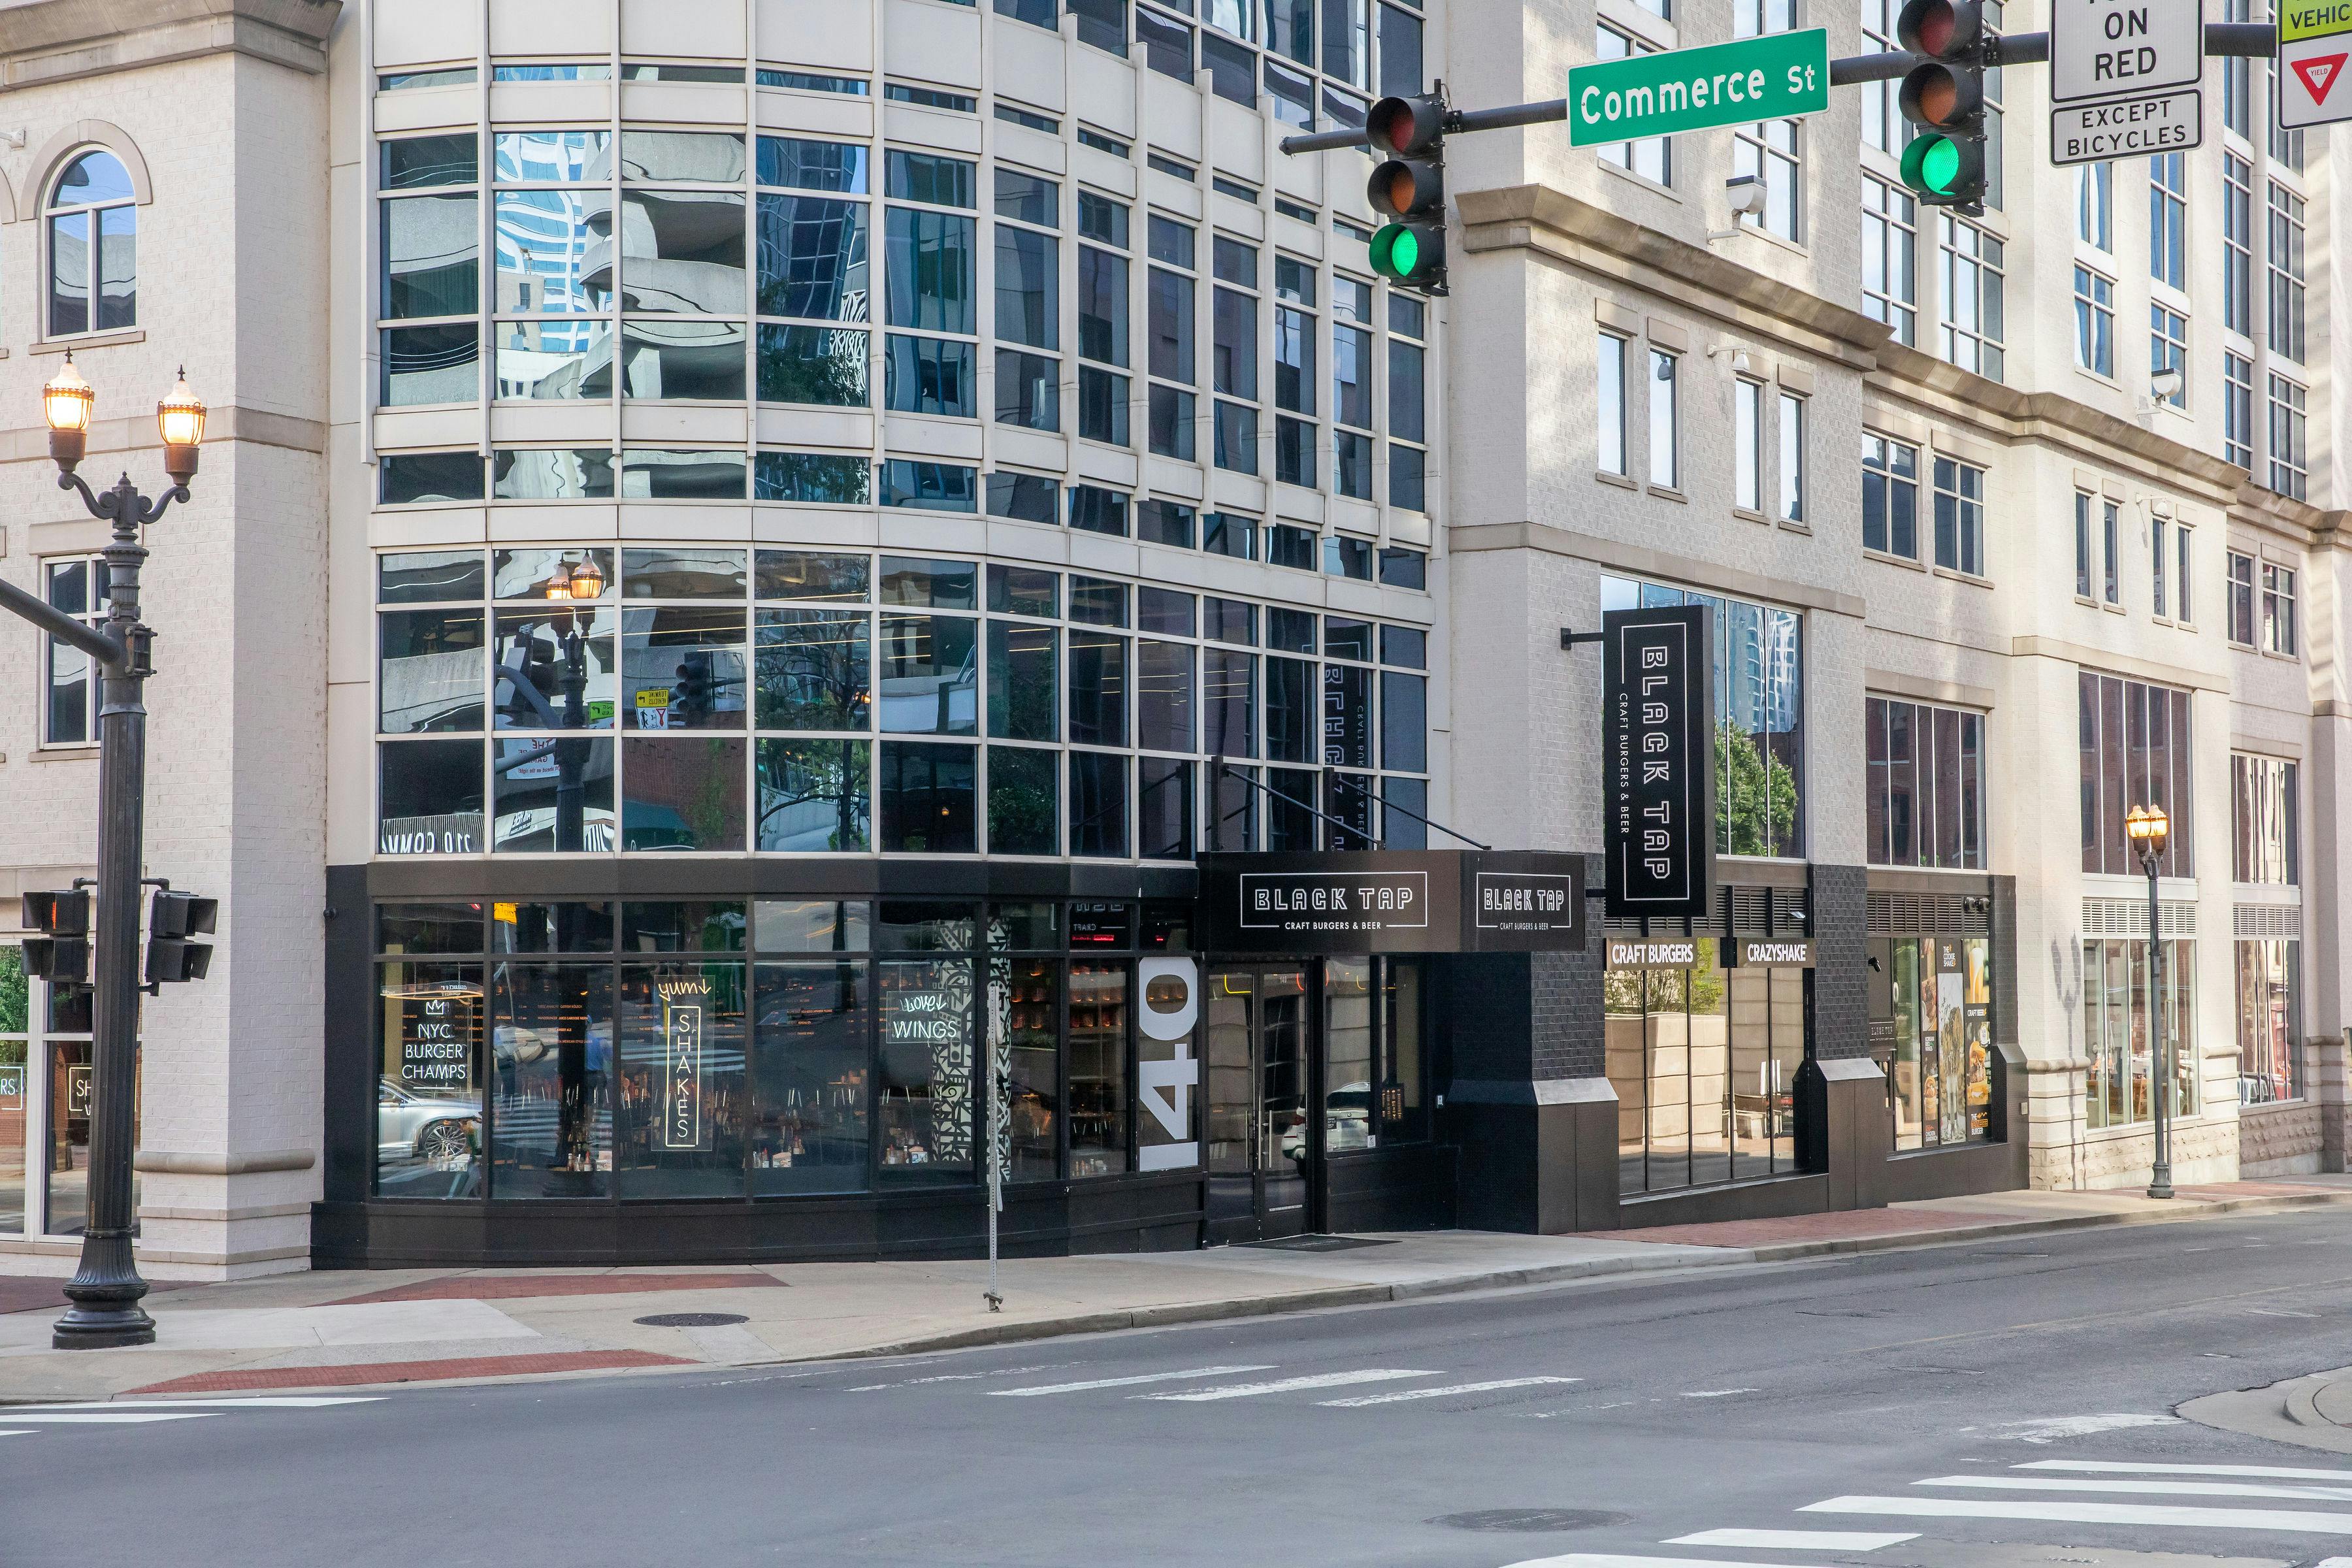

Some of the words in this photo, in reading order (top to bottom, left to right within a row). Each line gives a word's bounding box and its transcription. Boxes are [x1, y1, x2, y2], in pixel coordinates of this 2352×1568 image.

[2104, 8, 2148, 40] ON
[2095, 46, 2157, 81] RED
[2310, 67, 2328, 76] YIELD
[1581, 69, 1765, 124] Commerce
[1788, 64, 1815, 94] St
[2082, 100, 2171, 129] EXCEPT
[2067, 124, 2186, 157] BICYCLES
[1619, 693, 1629, 730] CRAFT
[1642, 645, 1670, 785] BLACK
[1620, 734, 1629, 788] BURGERS
[1620, 792, 1629, 801] &
[1620, 806, 1629, 834] BEER
[1644, 800, 1671, 879] TAP
[1254, 887, 1347, 911] BLACK
[1359, 887, 1413, 910] TAP
[1484, 888, 1533, 911] BLACK
[1537, 889, 1564, 911] TAP
[1284, 921, 1310, 931] CRAFT
[1313, 921, 1349, 930] BURGERS
[1352, 921, 1359, 930] &
[1362, 921, 1382, 930] BEER
[1612, 944, 1646, 964] CRAFT
[1648, 943, 1693, 964] BURGERS
[418, 1023, 452, 1039] NYC
[893, 1021, 957, 1039] WINGS
[406, 1044, 463, 1058] BURGER
[1139, 956, 1198, 1171] 140
[401, 1064, 466, 1080] CHAMPS
[676, 1014, 692, 1138] SHAKES
